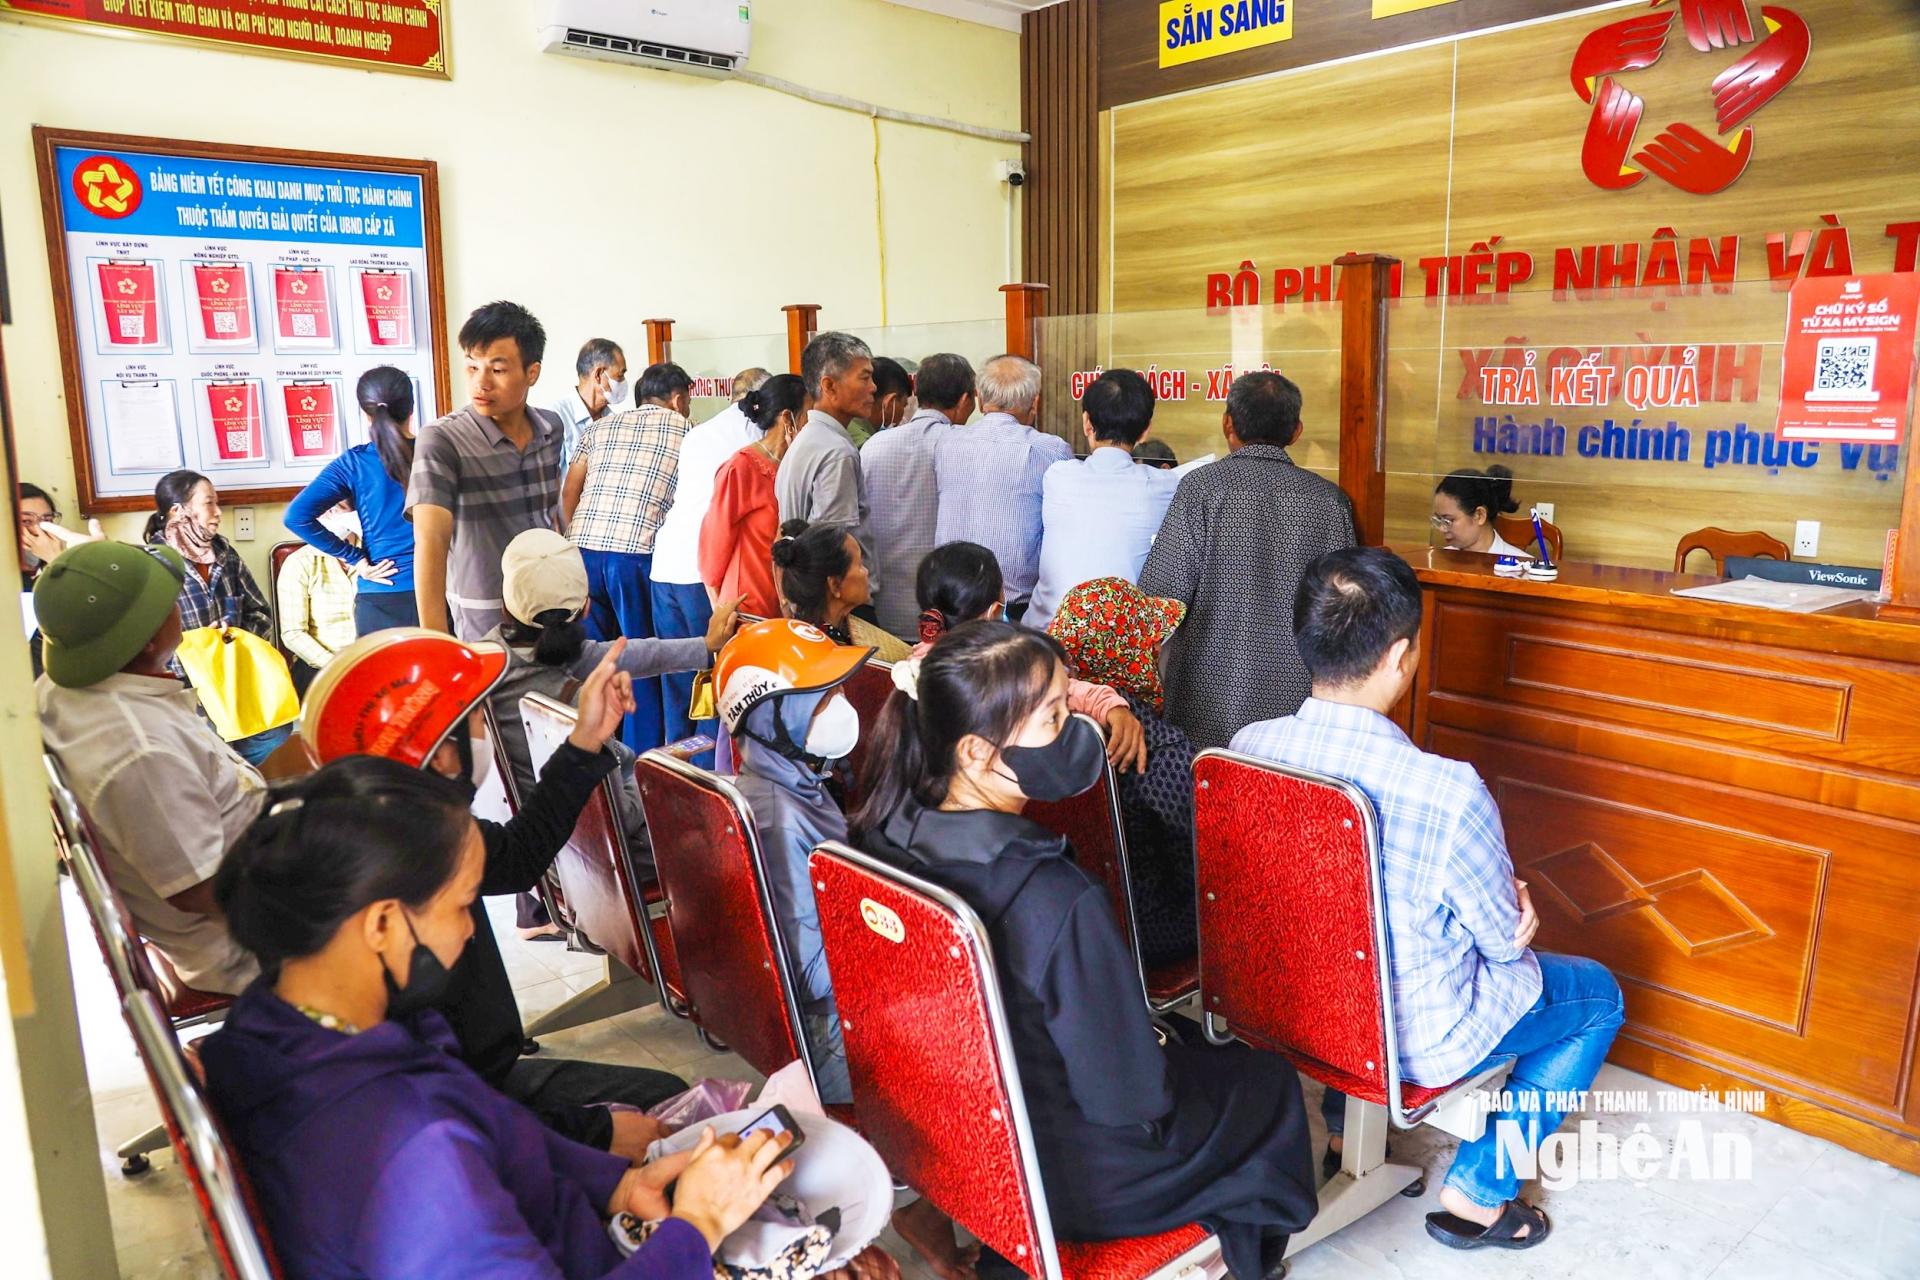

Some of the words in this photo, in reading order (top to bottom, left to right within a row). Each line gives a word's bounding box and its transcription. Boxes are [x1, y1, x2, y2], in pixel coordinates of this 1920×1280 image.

[198, 6, 219, 28] GIAN
[221, 6, 233, 30] VÀ
[235, 12, 250, 32] CHI
[251, 11, 267, 34] PHÍ
[268, 16, 286, 37] CHO
[287, 17, 313, 40] NGƯỜI
[335, 26, 363, 48] DOANH
[363, 29, 392, 55] NGHIỆP
[404, 5, 428, 28] CHÍNH
[1166, 3, 1213, 49] SẴN
[150, 166, 178, 192] BẢNG
[180, 171, 206, 194] NIÊM
[207, 170, 224, 195] YẾT
[226, 174, 252, 197] CÔNG
[254, 179, 276, 199] KHAI
[277, 181, 302, 200] DANH
[304, 182, 324, 205] MỤC
[326, 179, 343, 203] THỦ
[344, 186, 361, 208] TỤC
[362, 184, 386, 206] HÀNH
[387, 186, 413, 208] CHÍNH
[176, 204, 208, 231] THUỘC
[209, 201, 237, 228] THẨM
[271, 206, 289, 231] GIẢI
[291, 208, 318, 234] QUYẾT
[320, 209, 338, 234] CỦA
[340, 216, 363, 235] UBND
[364, 212, 381, 236] CẤP
[383, 216, 395, 237] XÃ
[1418, 235, 1535, 307] TIẾP
[1551, 226, 1740, 312] NHẬN
[1765, 213, 1854, 293] VÀ
[1801, 315, 1820, 328] TỪ
[1822, 318, 1842, 327] XA
[1842, 315, 1900, 327] MYSIGN
[1815, 302, 1844, 316] CHỮ
[1845, 301, 1866, 314] KÝ
[1867, 297, 1888, 314] SỐ
[1135, 364, 1187, 401] ÁCH
[1480, 350, 1539, 405] TRẢ
[1551, 353, 1616, 406] KẾT
[1625, 346, 1700, 411] QUẢ
[1472, 414, 1568, 458] Hành
[1577, 418, 1692, 462] chính
[1808, 569, 1869, 586] ViewSonic
